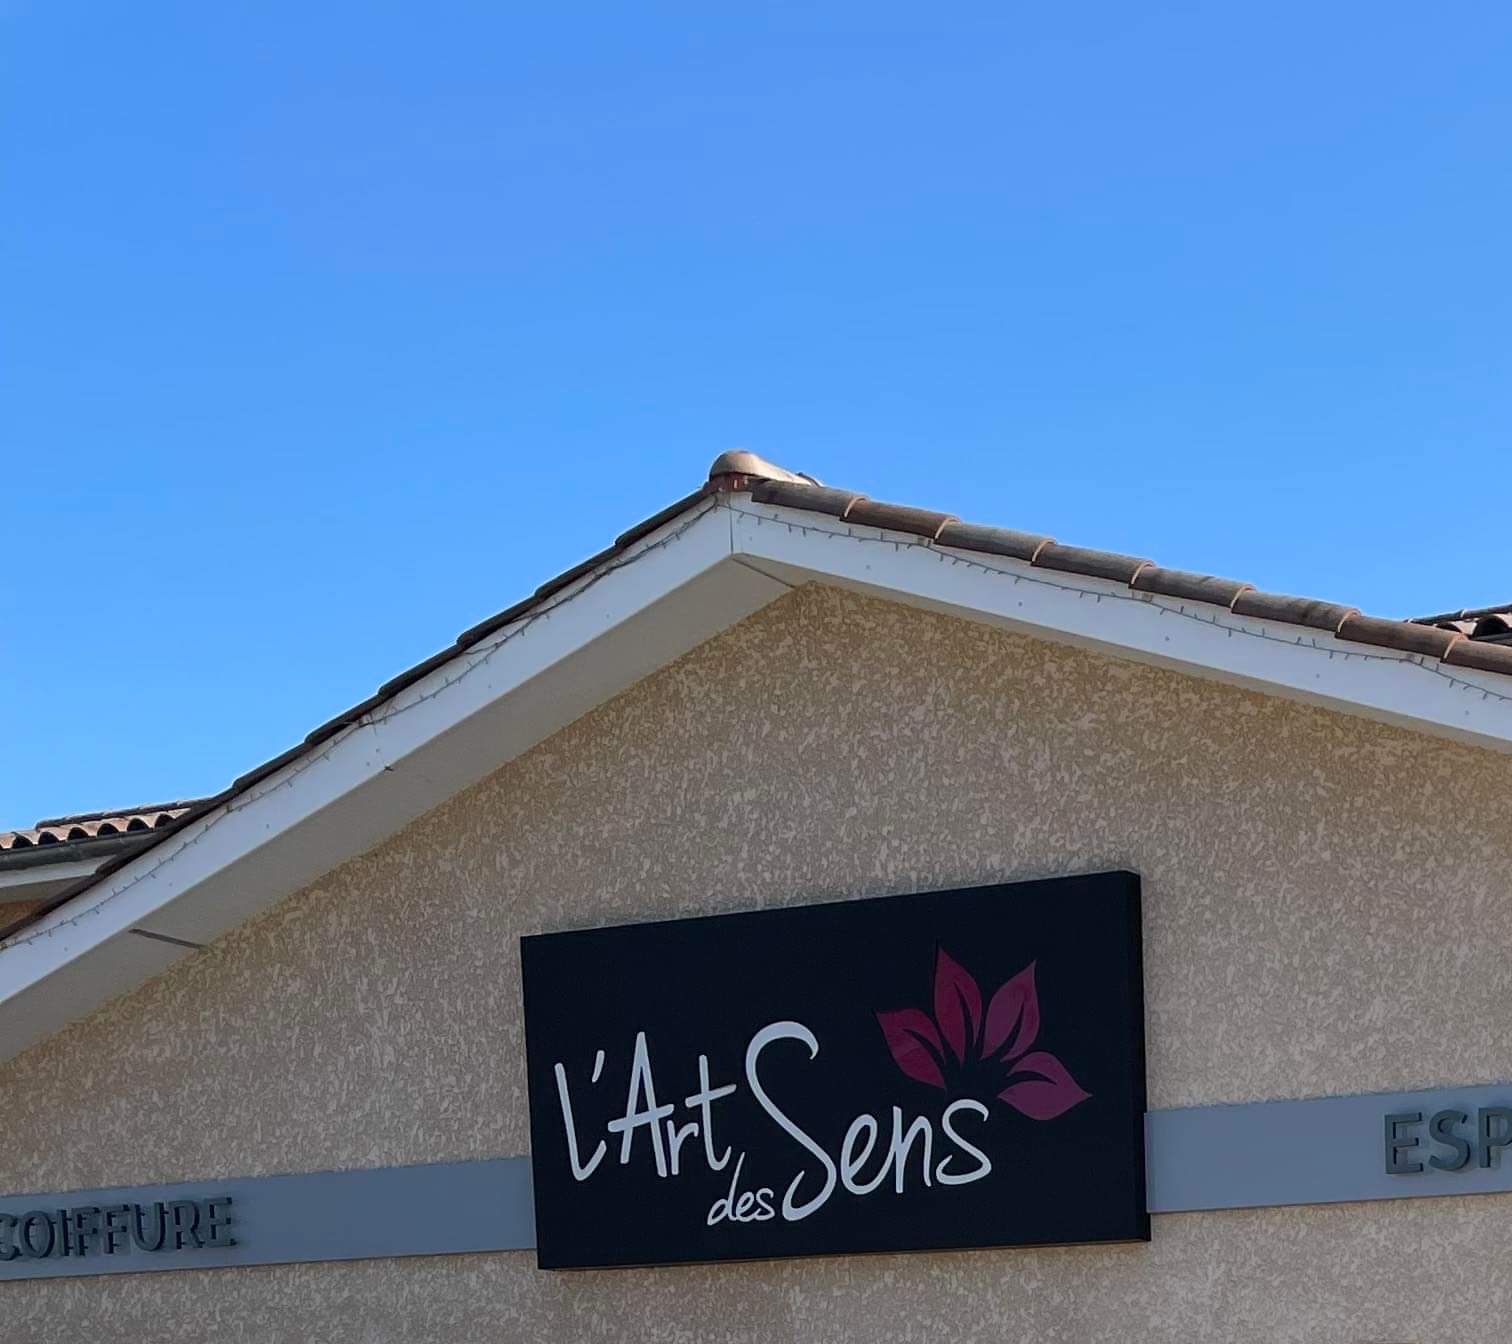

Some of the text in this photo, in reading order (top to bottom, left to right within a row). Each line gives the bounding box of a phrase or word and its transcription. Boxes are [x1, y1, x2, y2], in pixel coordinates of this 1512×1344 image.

[554, 1020, 992, 1226] L'Art des Sens
